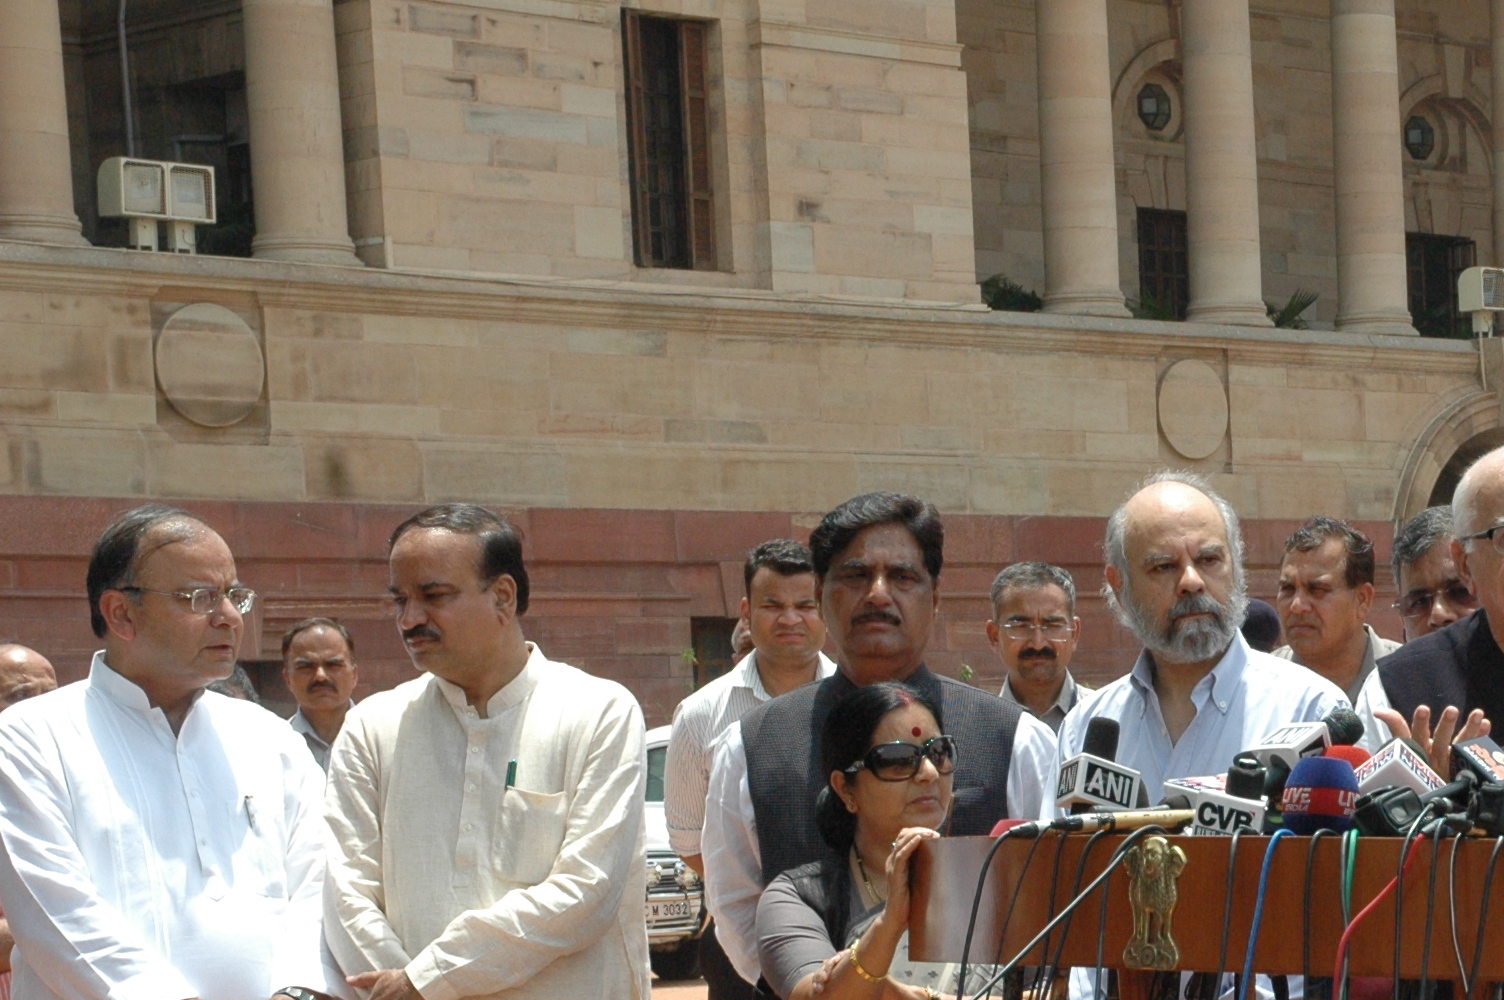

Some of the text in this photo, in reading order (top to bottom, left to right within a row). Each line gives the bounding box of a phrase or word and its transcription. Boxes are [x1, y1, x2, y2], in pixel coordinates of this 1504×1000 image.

[1263, 727, 1314, 745] ANI
[1058, 763, 1077, 796] ANI
[1086, 767, 1131, 804] ANI
[1282, 787, 1312, 804] LIVE
[663, 903, 688, 916] 3032
